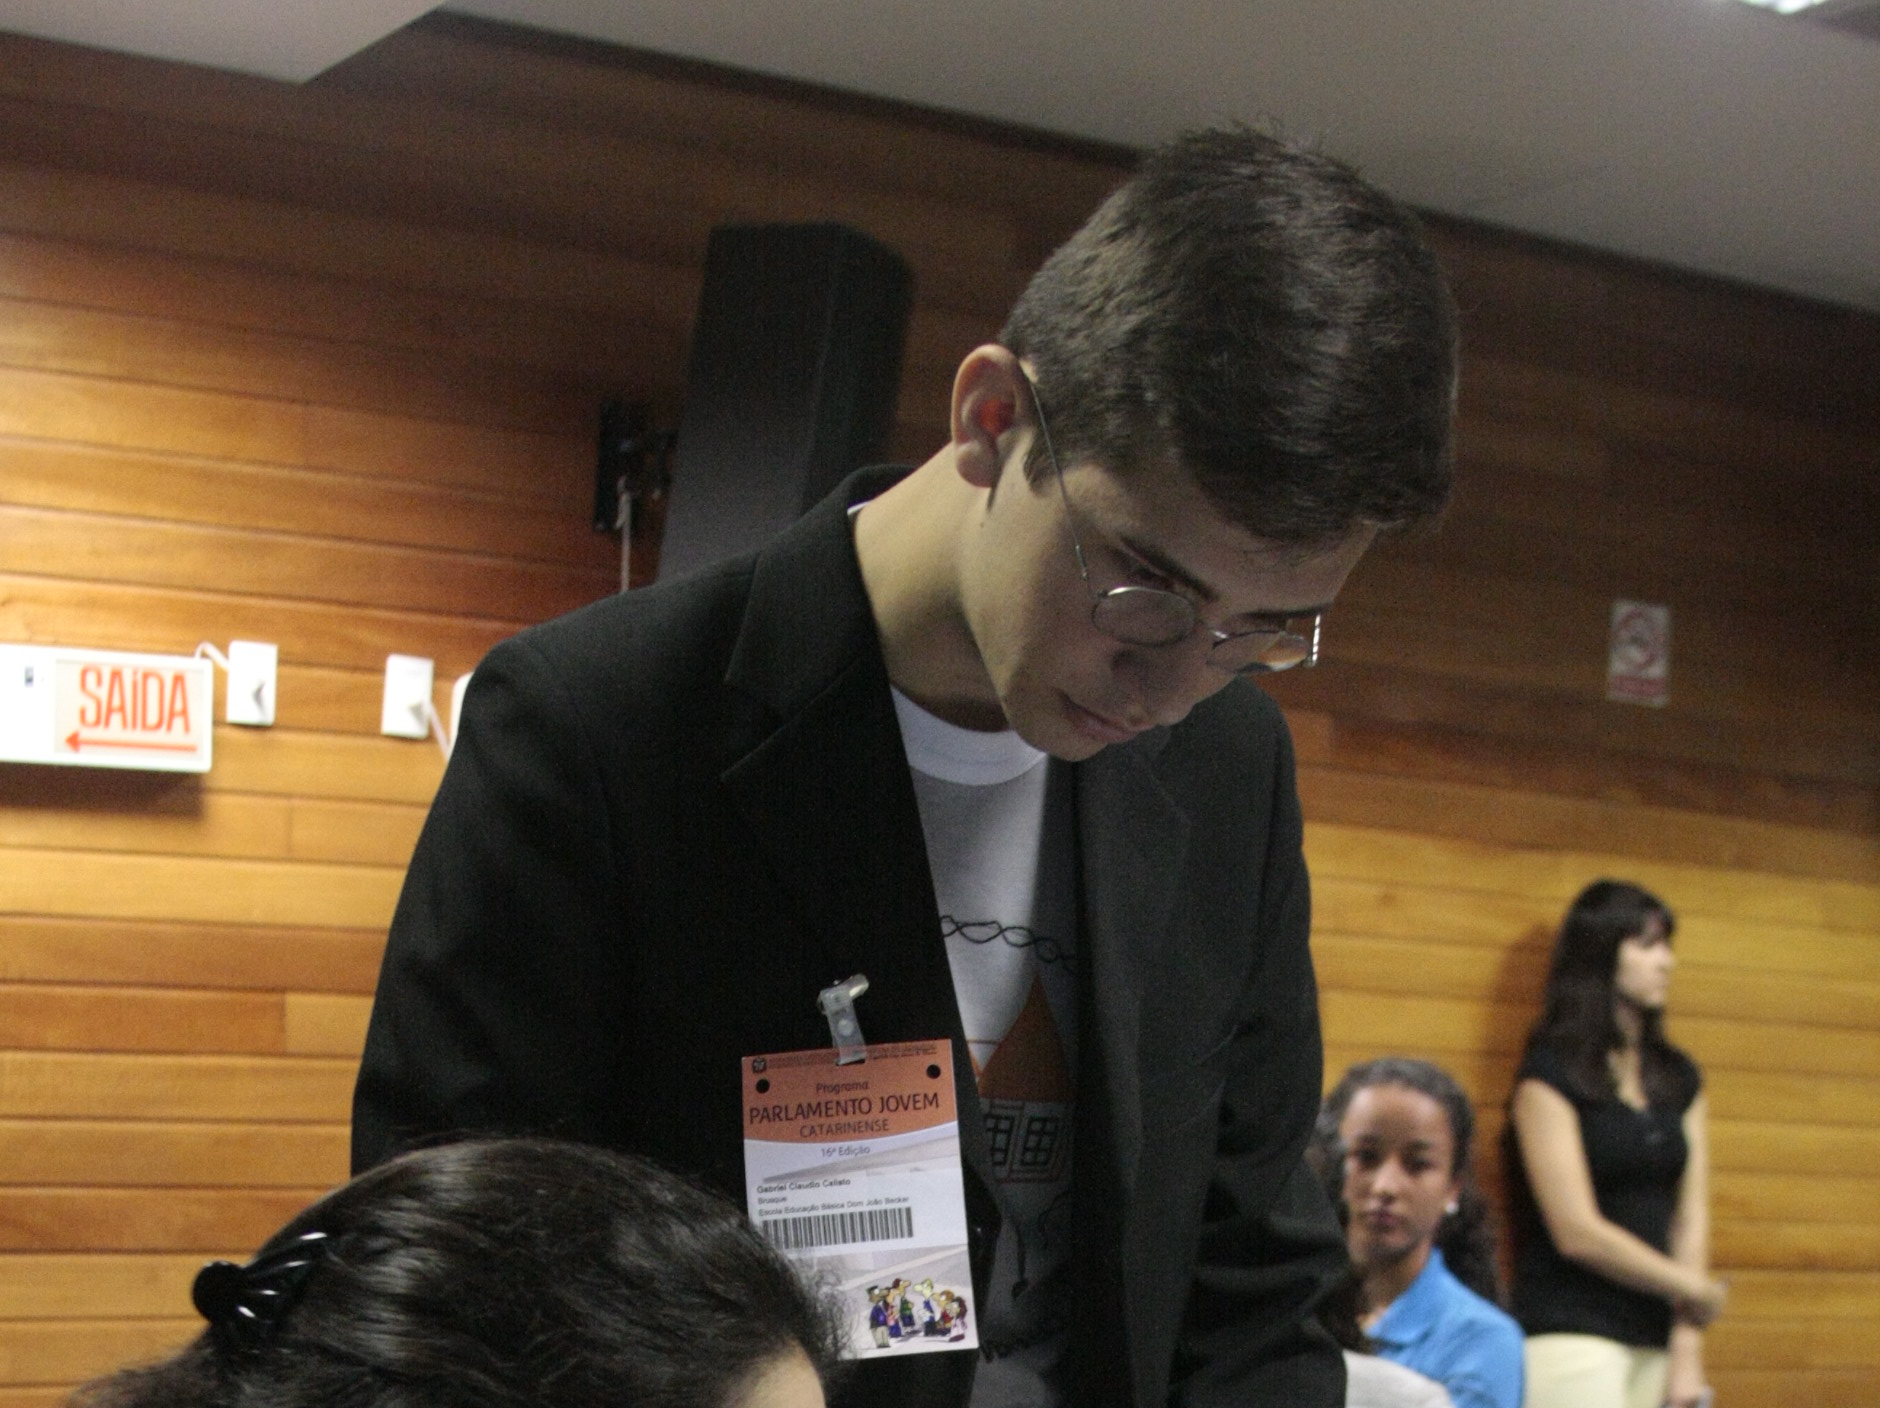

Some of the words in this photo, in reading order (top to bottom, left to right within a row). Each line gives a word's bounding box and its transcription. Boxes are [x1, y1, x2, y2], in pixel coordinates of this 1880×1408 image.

[79, 664, 191, 735] SAÍDA
[816, 1081, 869, 1095] Programa
[750, 1096, 873, 1124] PARLAMENTO
[879, 1092, 940, 1114] JOVEM
[800, 1119, 889, 1138] CATARINENSE
[838, 1145, 871, 1157] Edição
[757, 1184, 787, 1194] Gabriel
[758, 1208, 782, 1217] Escola
[784, 1204, 819, 1214] Educação
